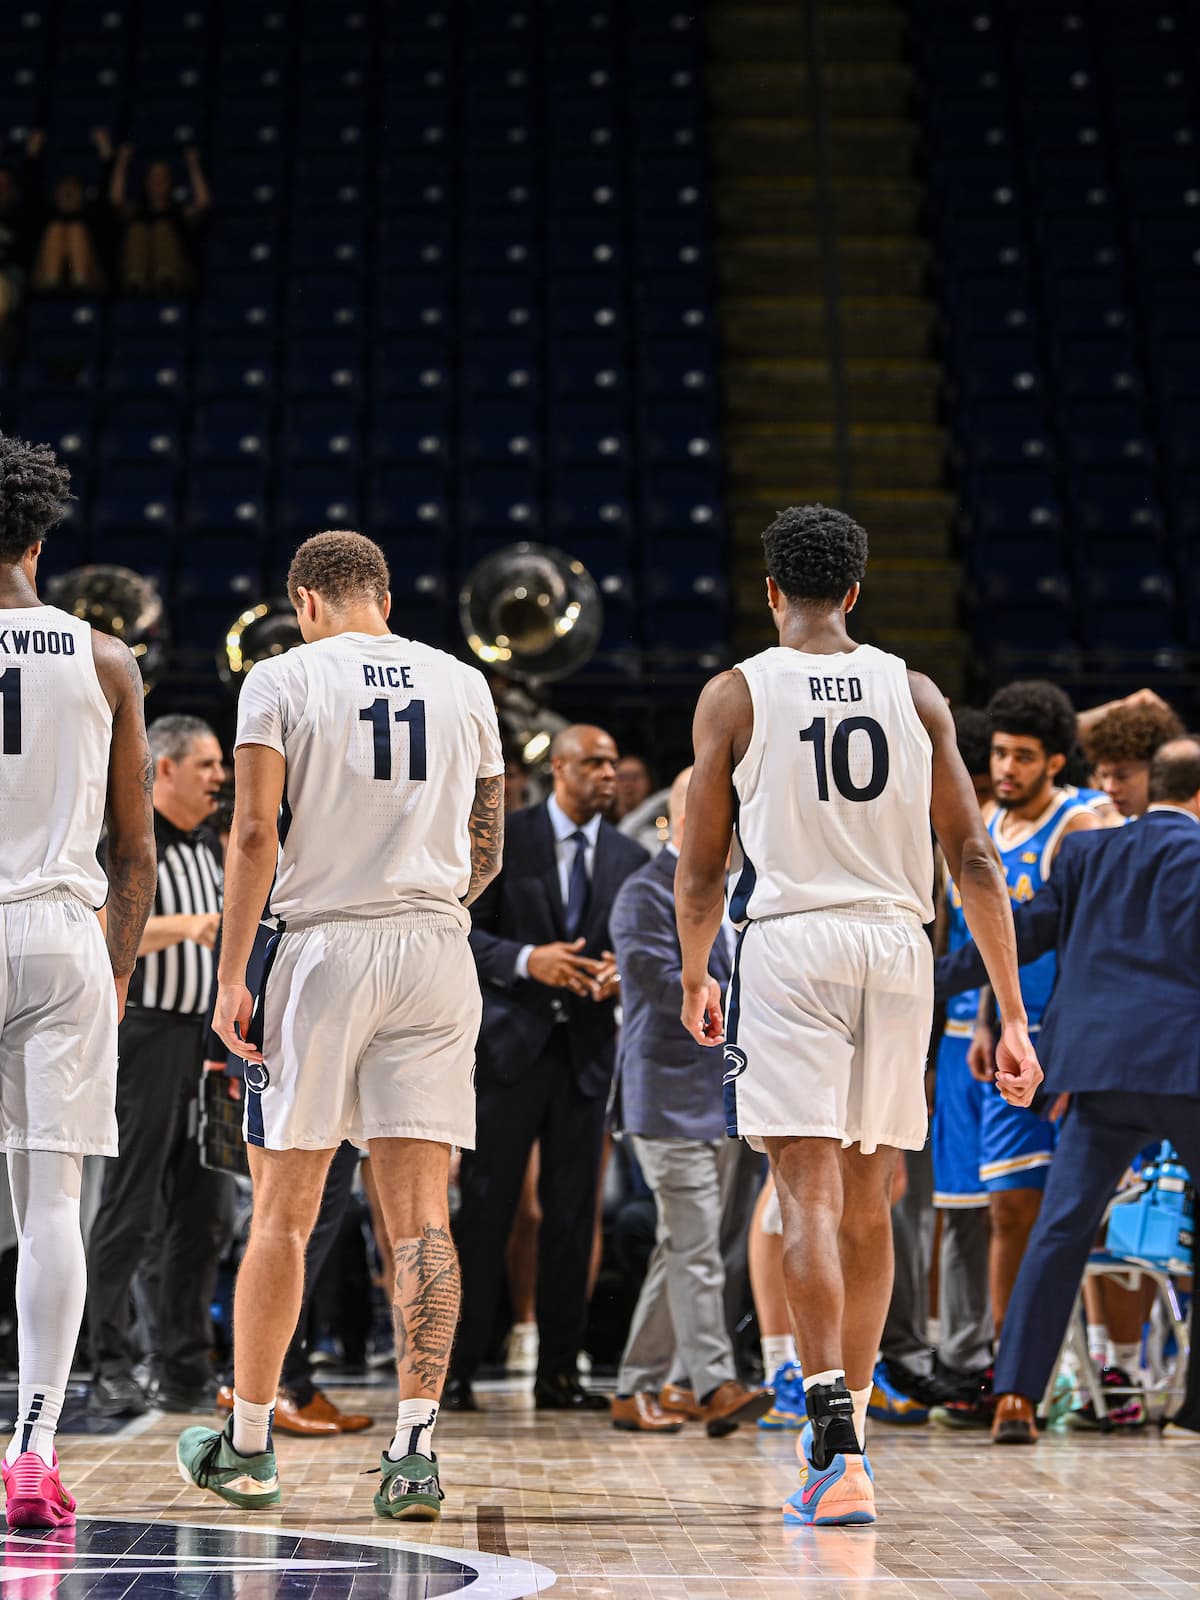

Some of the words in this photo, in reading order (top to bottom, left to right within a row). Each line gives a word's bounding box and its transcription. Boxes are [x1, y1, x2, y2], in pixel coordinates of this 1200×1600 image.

[363, 664, 414, 689] RICE
[808, 676, 863, 703] REED
[359, 698, 427, 781] 11
[799, 716, 889, 802] 10
